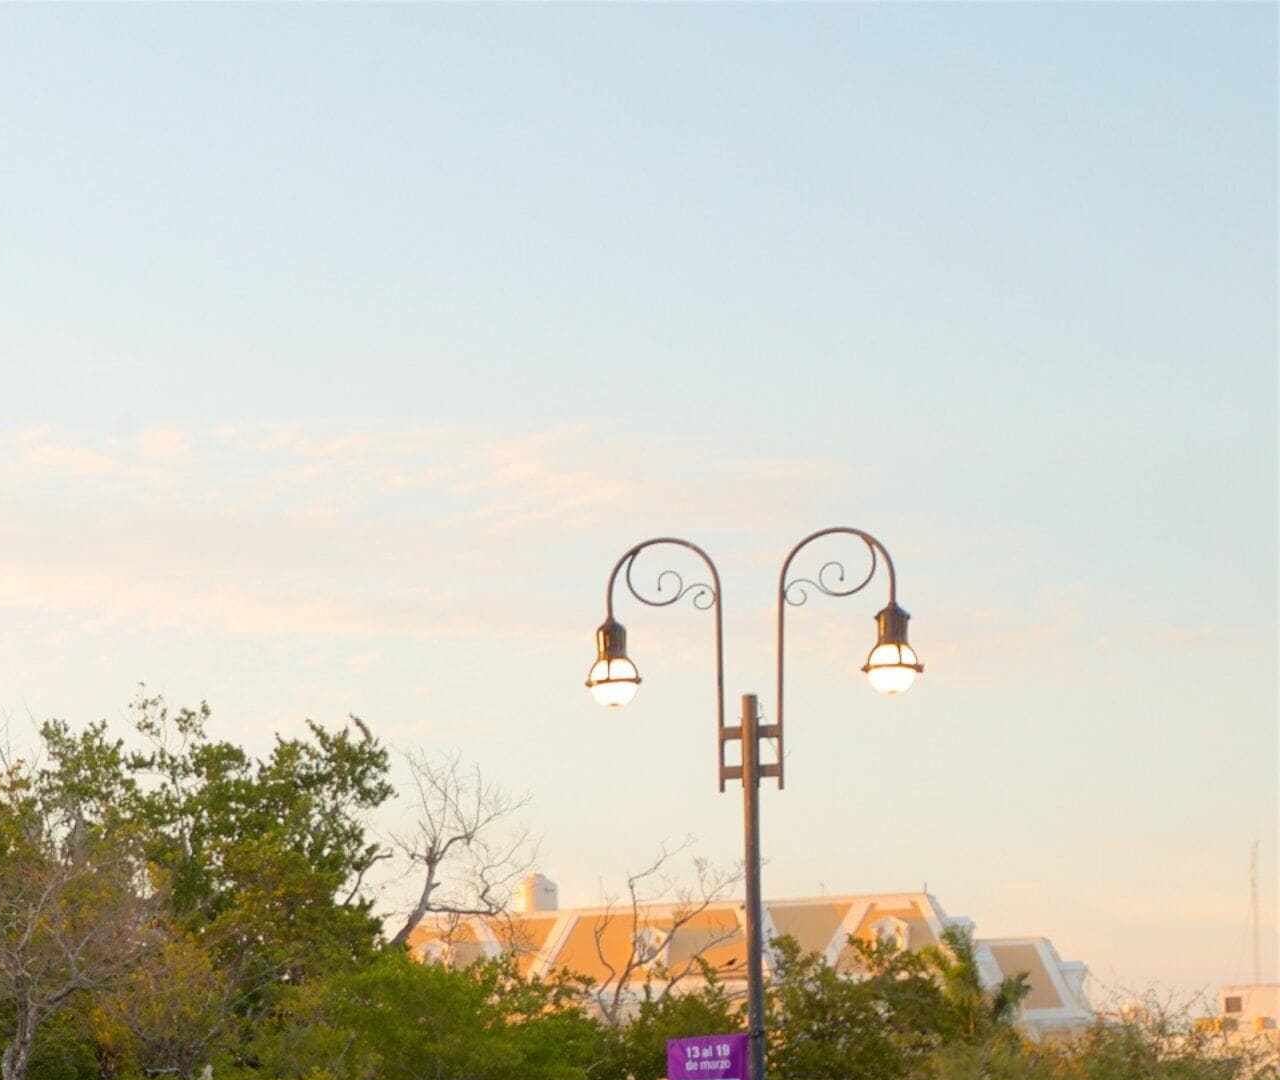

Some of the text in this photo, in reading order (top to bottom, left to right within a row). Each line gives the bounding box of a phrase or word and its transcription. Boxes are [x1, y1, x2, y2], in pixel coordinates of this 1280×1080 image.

[686, 1043, 730, 1059] 13 al 19
[685, 1060, 731, 1071] de marzo
